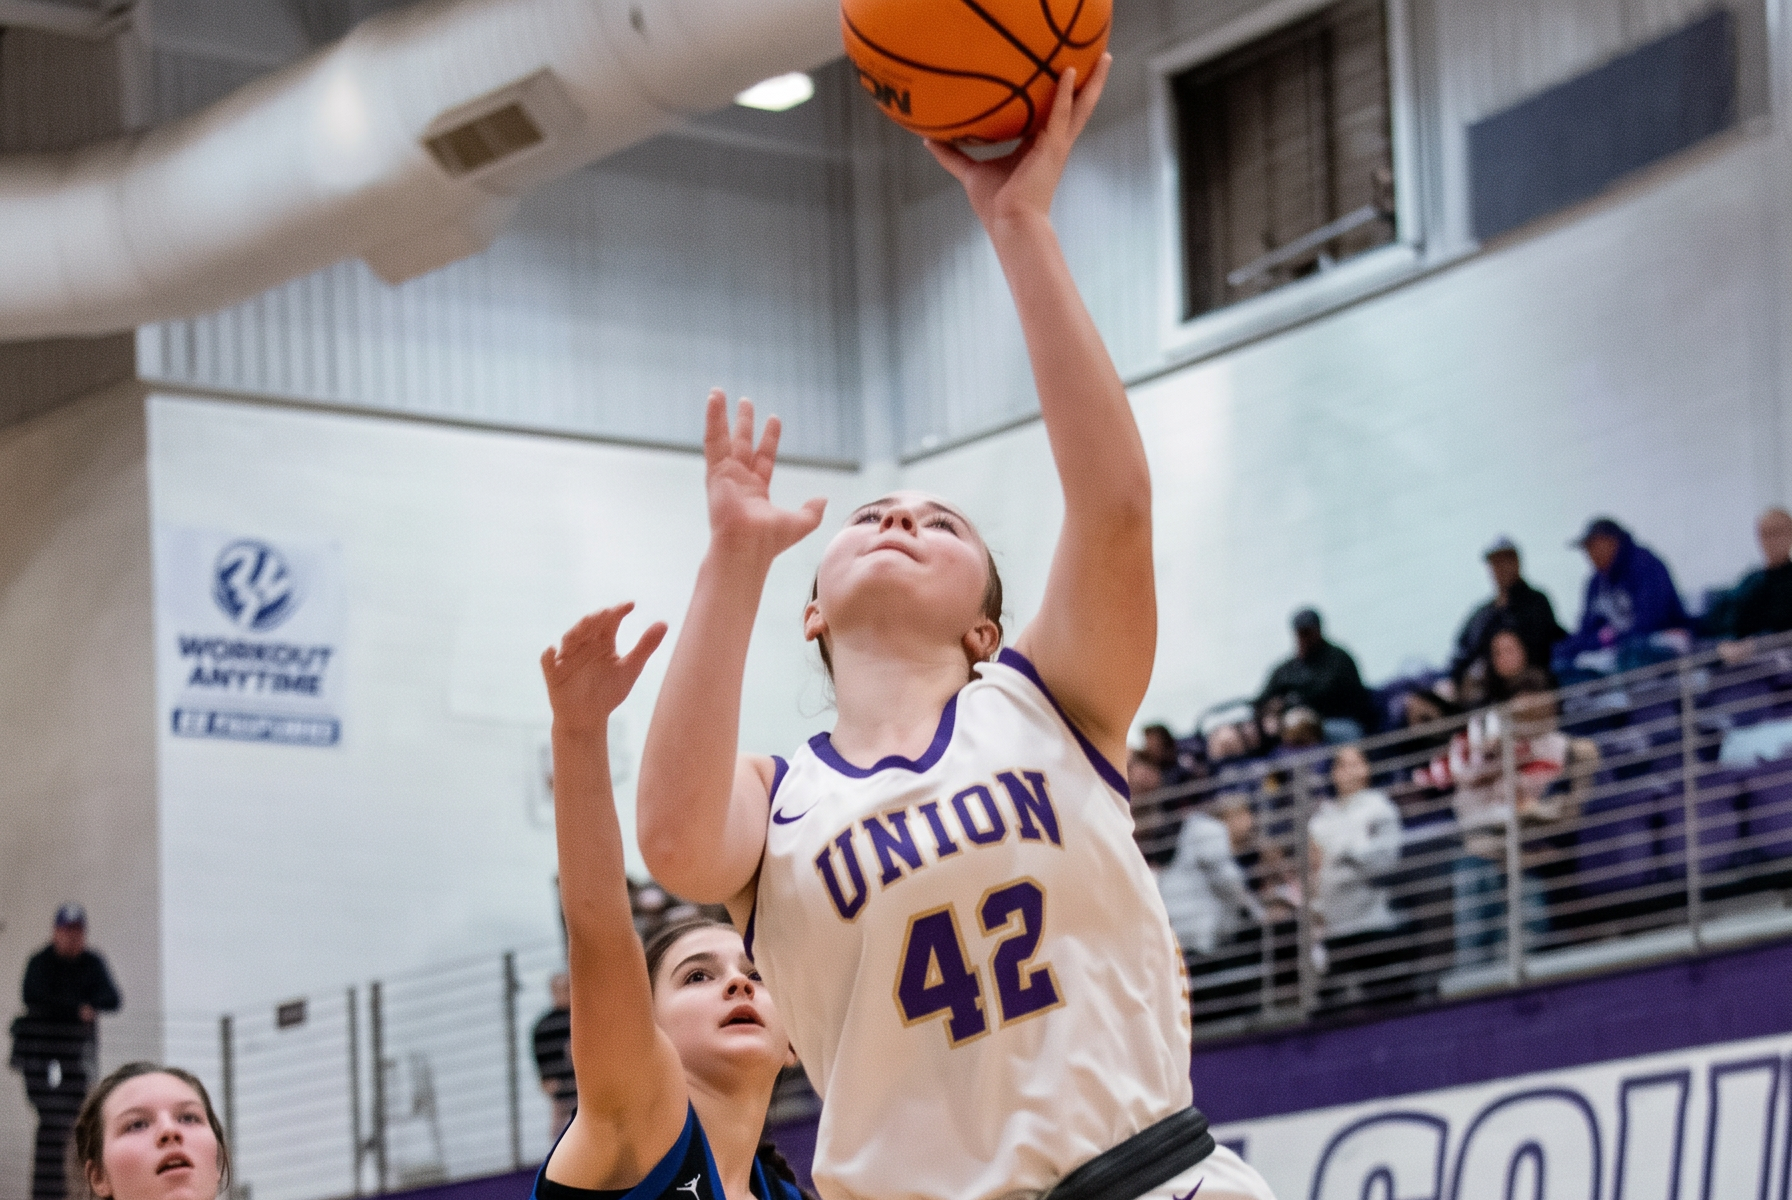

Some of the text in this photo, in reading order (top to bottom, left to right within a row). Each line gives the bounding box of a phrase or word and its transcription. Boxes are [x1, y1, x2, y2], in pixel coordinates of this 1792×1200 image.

[178, 635, 333, 672] WORKOUT
[188, 666, 319, 696] ANYTIME
[813, 767, 1065, 924] UNION
[892, 876, 1067, 1050] 42
